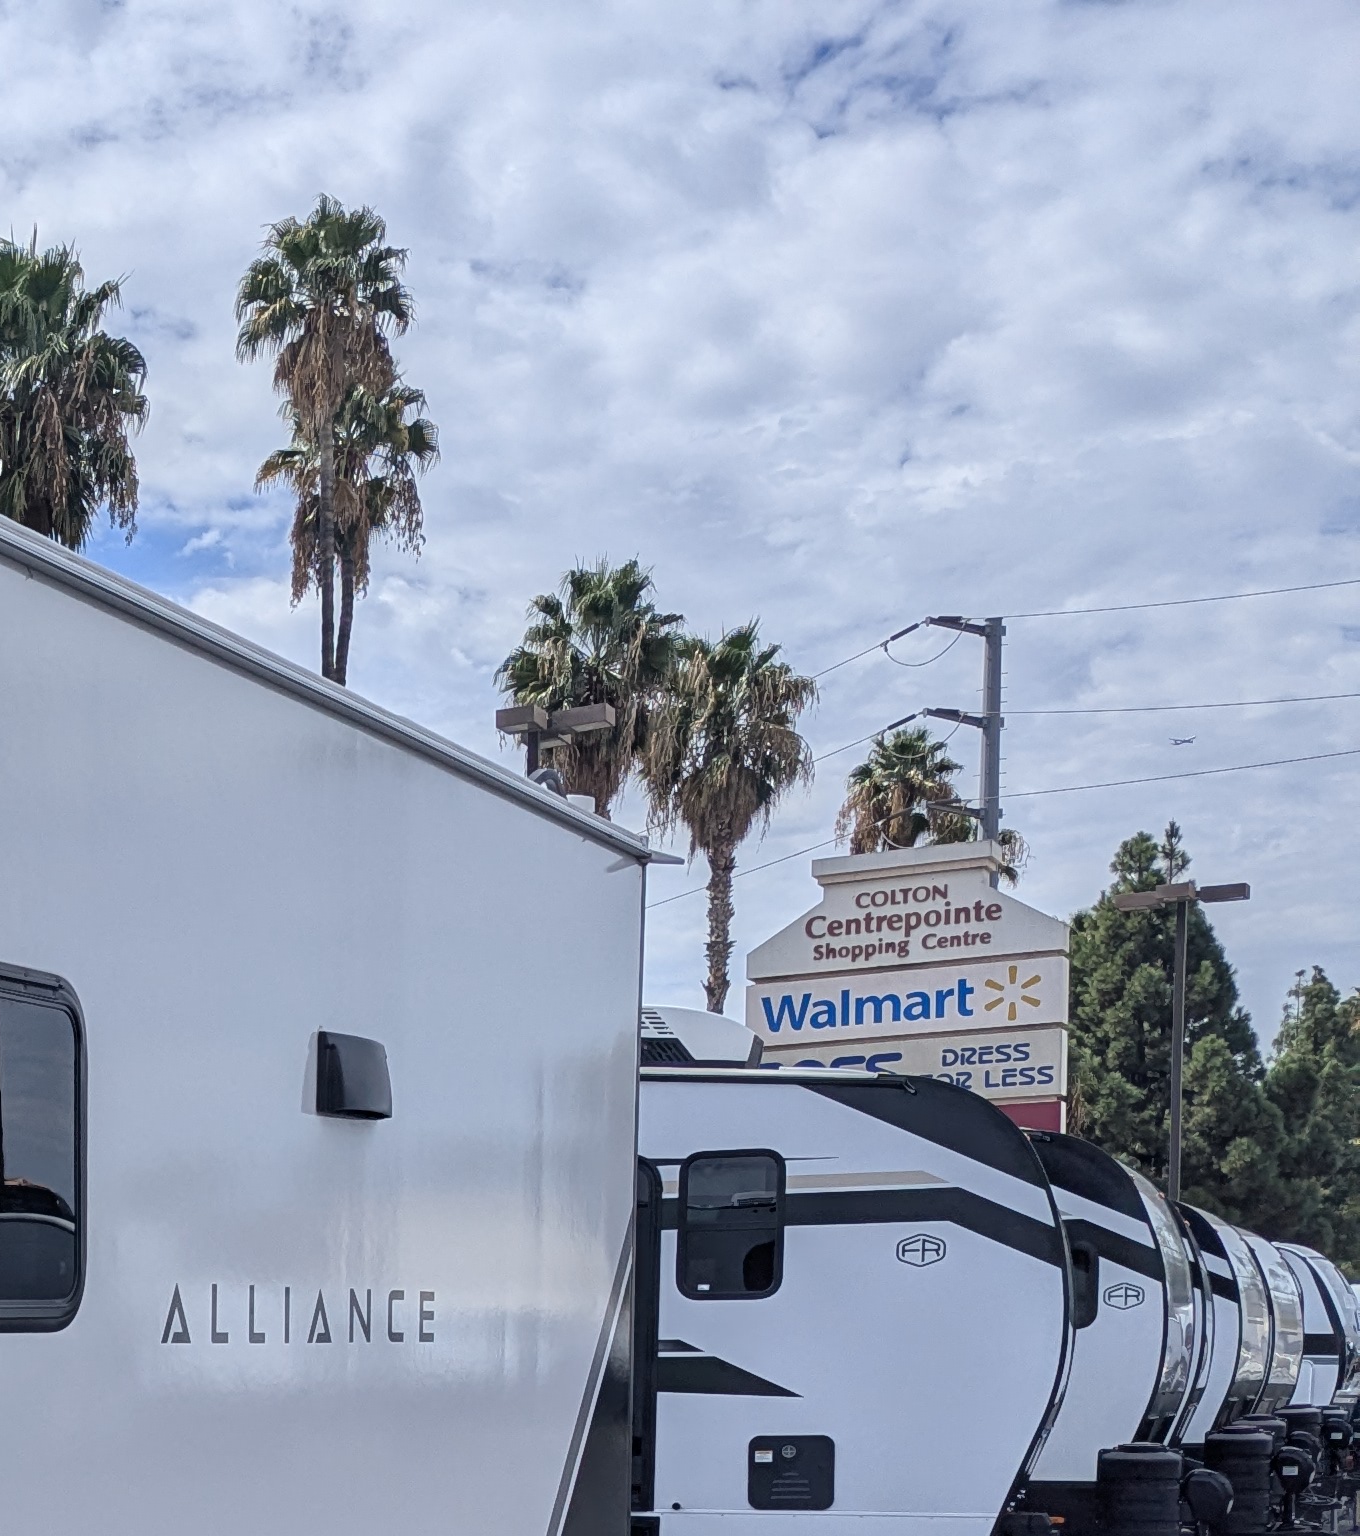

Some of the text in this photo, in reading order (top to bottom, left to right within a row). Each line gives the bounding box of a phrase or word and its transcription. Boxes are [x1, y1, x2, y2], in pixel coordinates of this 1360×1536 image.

[855, 884, 948, 909] COLTON
[805, 899, 1002, 938] Centrepointe
[813, 930, 992, 962] Shopping Centre
[761, 978, 974, 1033] Walmart
[941, 1043, 1030, 1067] DRESS
[984, 1066, 1054, 1089] LESS
[161, 1283, 435, 1344] ALLIANCE
